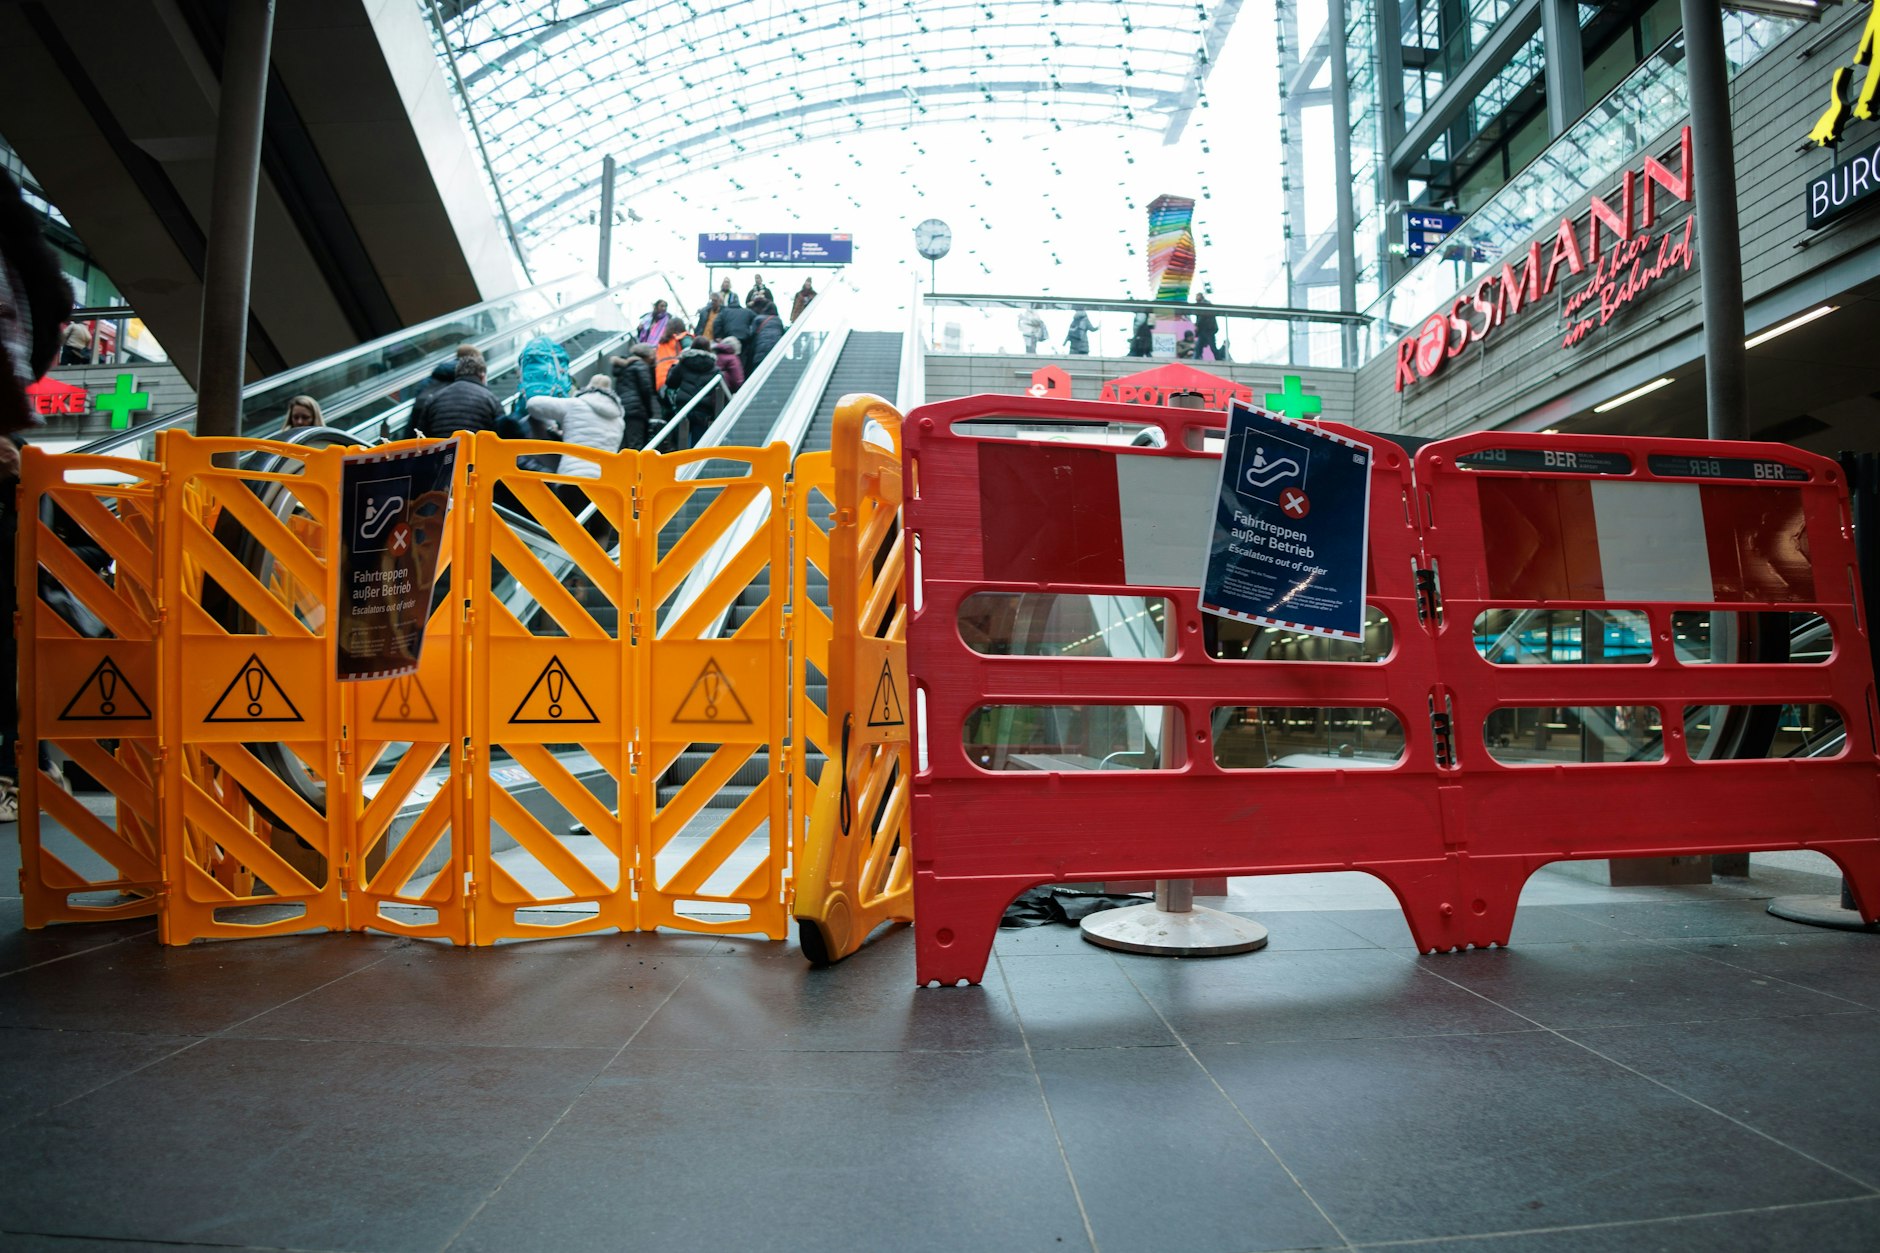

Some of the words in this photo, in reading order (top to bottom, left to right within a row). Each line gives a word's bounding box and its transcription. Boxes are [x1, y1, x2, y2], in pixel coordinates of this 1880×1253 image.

[1562, 317, 1595, 349] im
[1600, 213, 1693, 326] Bahnhof
[1099, 384, 1253, 409] APOTEKE
[1543, 450, 1577, 468] BER
[1754, 463, 1784, 480] BER
[1233, 510, 1307, 542] Fahrtreppen
[1231, 527, 1266, 546] außer
[1268, 536, 1315, 559] Betrieb
[1228, 543, 1274, 564] Escalators
[1275, 557, 1291, 568] out
[1291, 561, 1303, 572] of
[1302, 563, 1328, 576] order
[353, 567, 409, 583] Fahrtreppen
[352, 585, 381, 601] außer
[381, 580, 412, 597] Betrieb
[352, 605, 386, 616] Escalators
[386, 603, 396, 611] out
[396, 601, 403, 612] of
[402, 599, 416, 609] order
